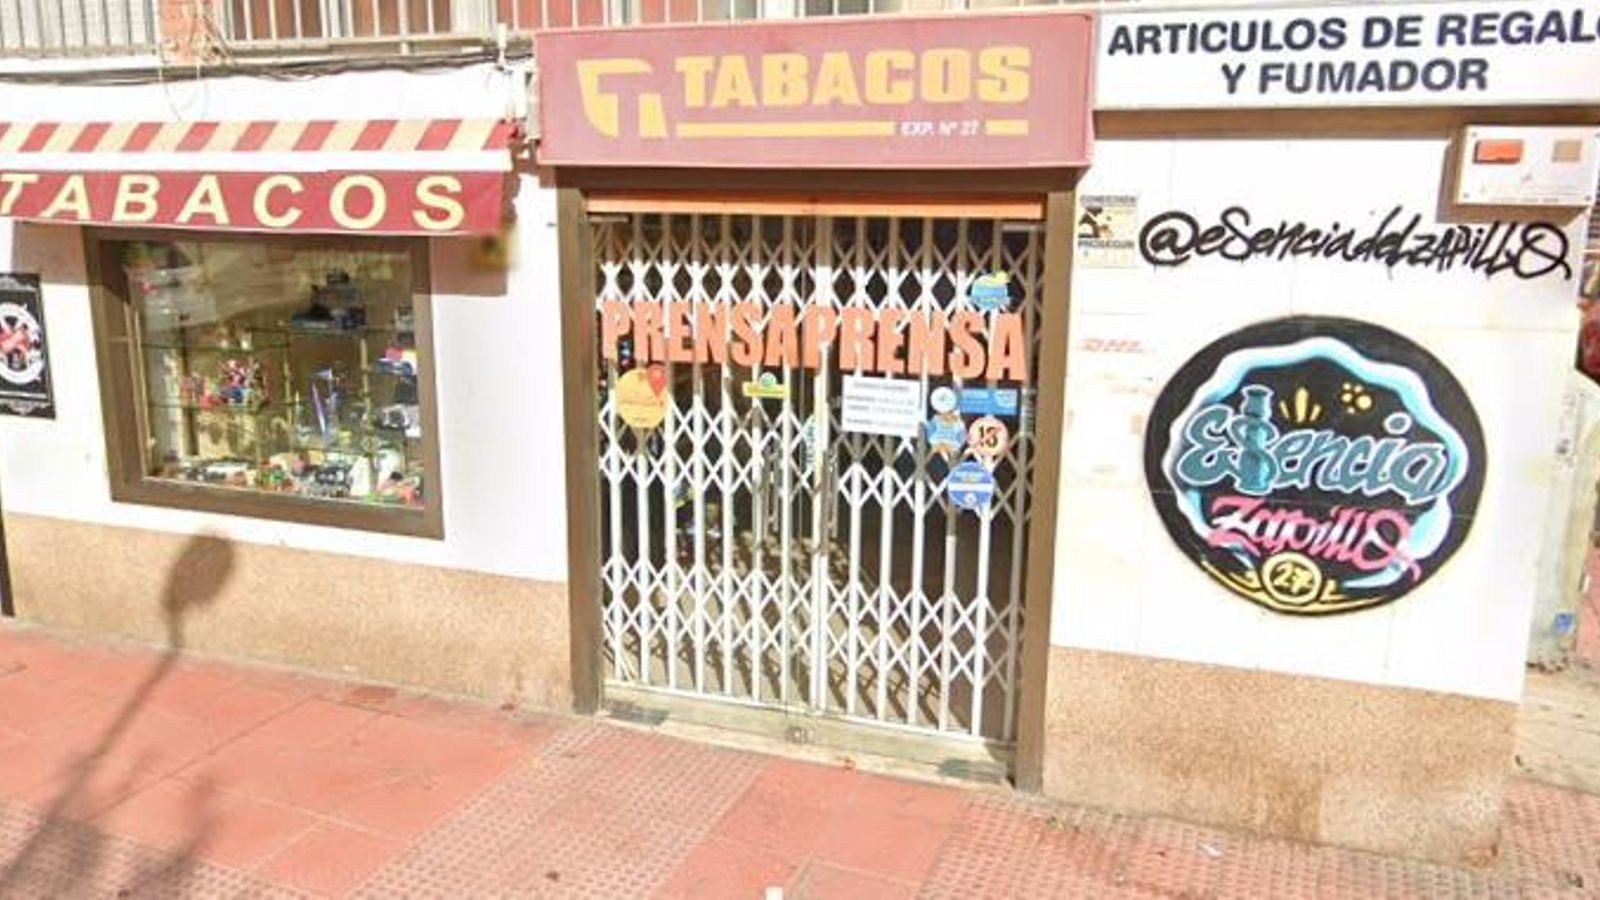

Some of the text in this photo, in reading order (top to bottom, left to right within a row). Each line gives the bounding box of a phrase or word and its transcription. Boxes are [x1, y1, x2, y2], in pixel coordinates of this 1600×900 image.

[1107, 9, 1600, 55] ARTICULOS DE REGAL
[675, 46, 1031, 107] TABACOS
[1222, 58, 1490, 94] Y FUMADOR
[0, 173, 466, 231] TABACOS
